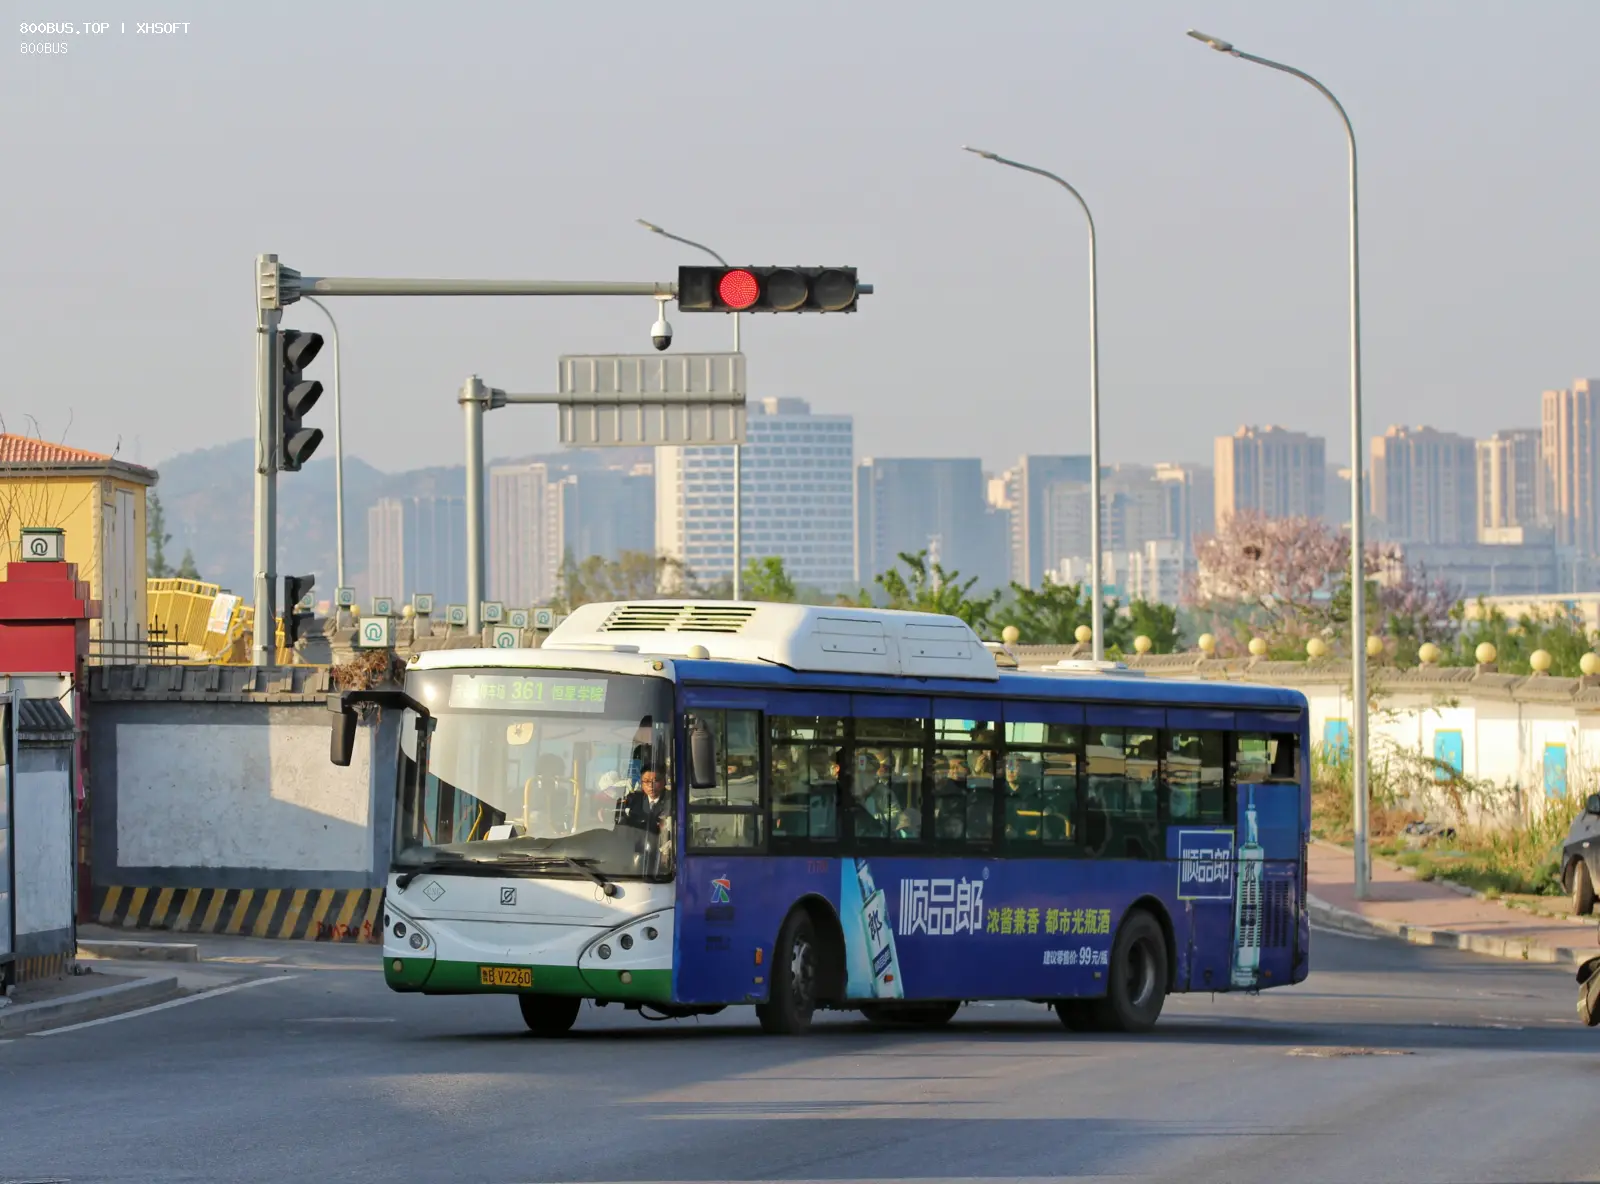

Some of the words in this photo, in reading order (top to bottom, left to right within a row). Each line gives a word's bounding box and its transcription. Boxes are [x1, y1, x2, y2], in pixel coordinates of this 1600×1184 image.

[511, 681, 543, 700] 361
[553, 684, 604, 702] 恒星学院
[1182, 848, 1230, 883] 顺品郎
[899, 876, 983, 935] 顺品郎
[986, 908, 1040, 934] 浓酱兼香
[1045, 908, 1111, 934] 都市光瓶酒
